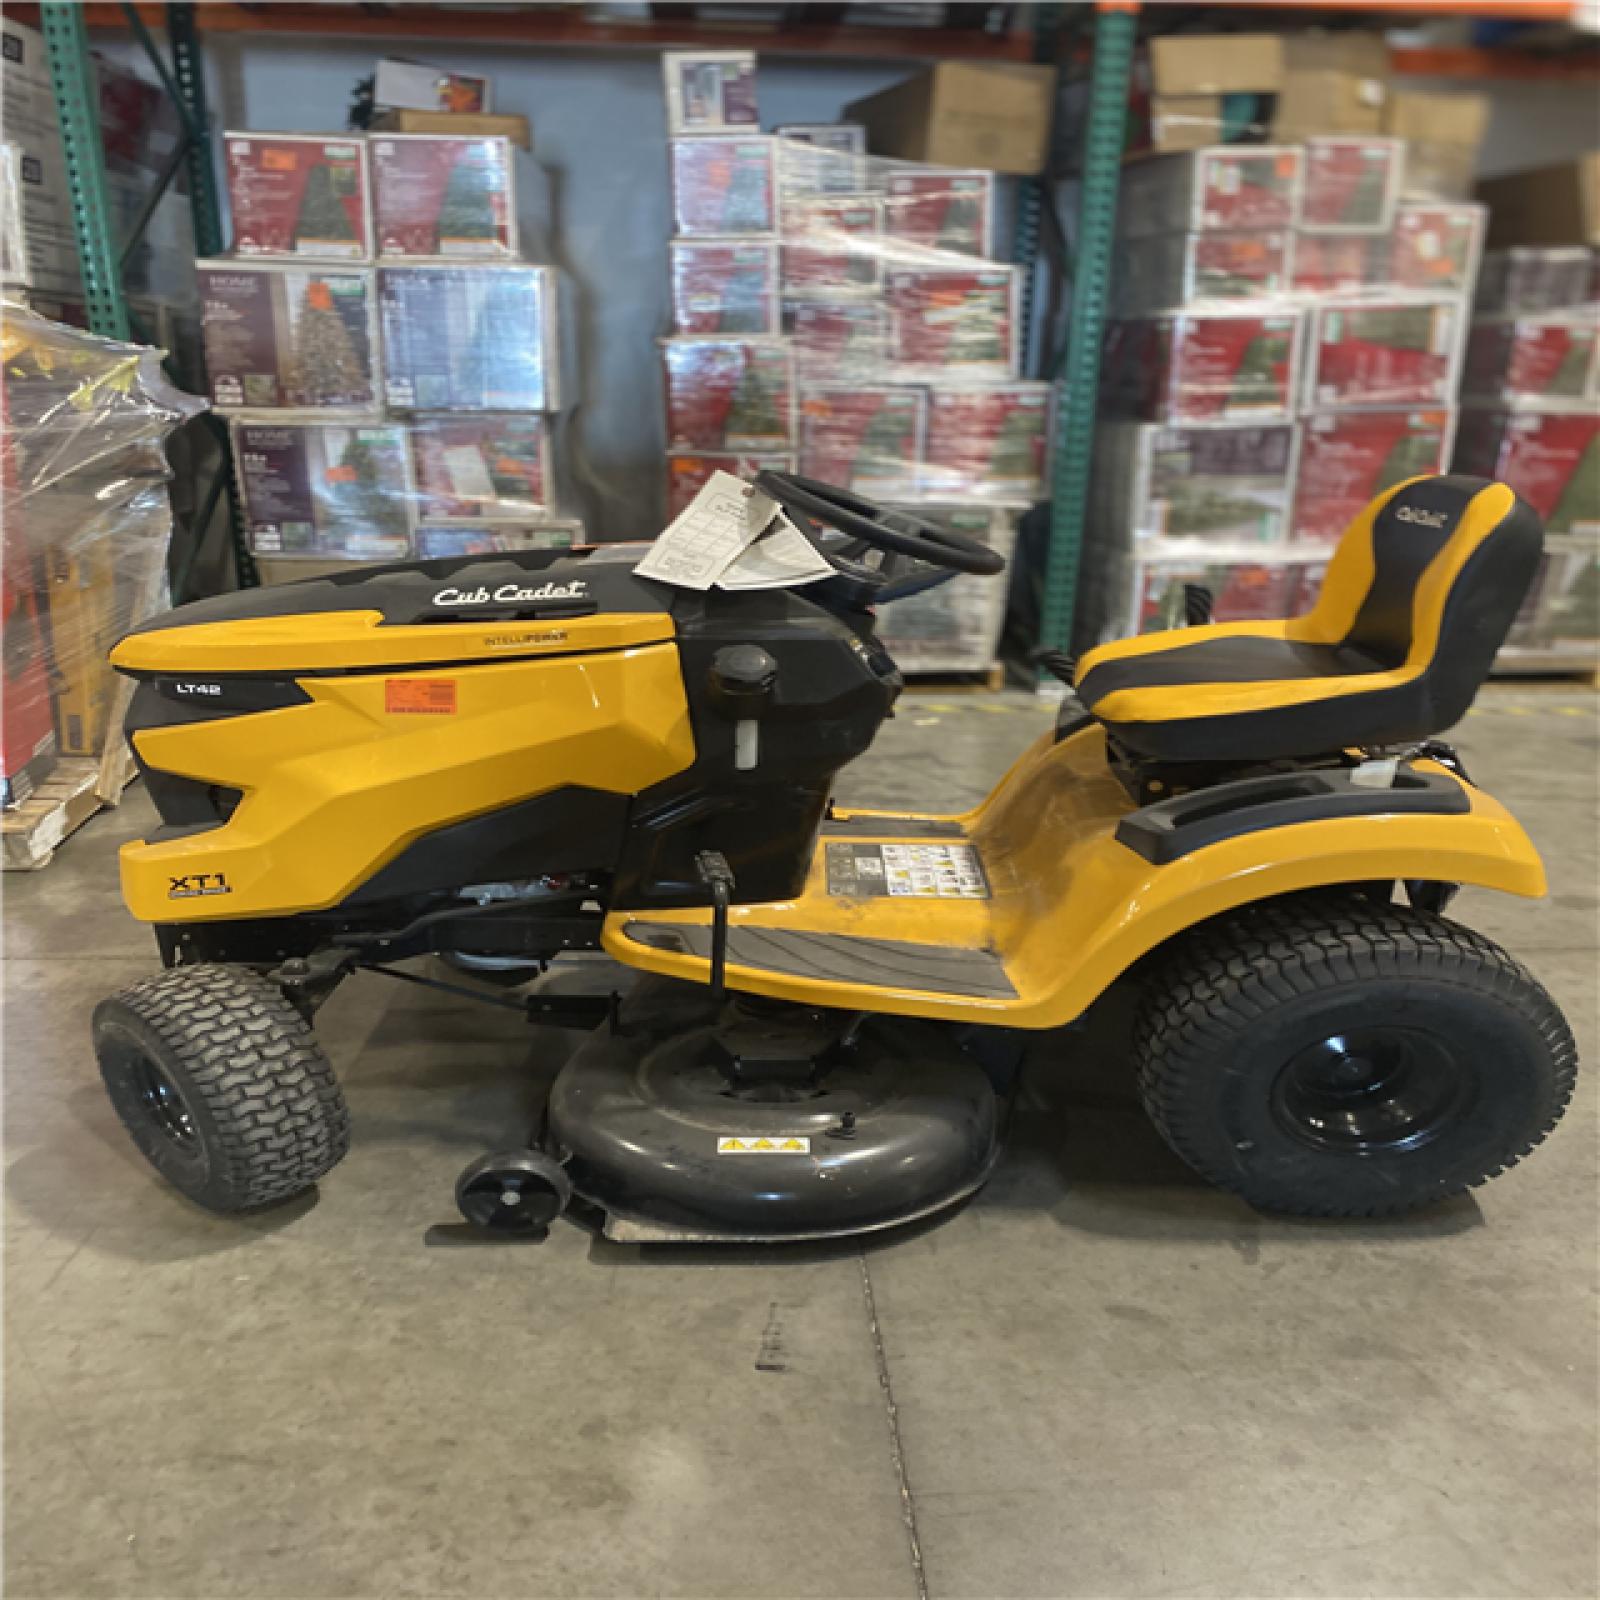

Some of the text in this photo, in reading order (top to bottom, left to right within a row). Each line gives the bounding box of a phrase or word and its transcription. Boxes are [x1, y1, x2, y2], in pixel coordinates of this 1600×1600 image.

[432, 580, 587, 606] Cub Cadet
[176, 684, 221, 696] LT42
[168, 873, 226, 890] XT1
